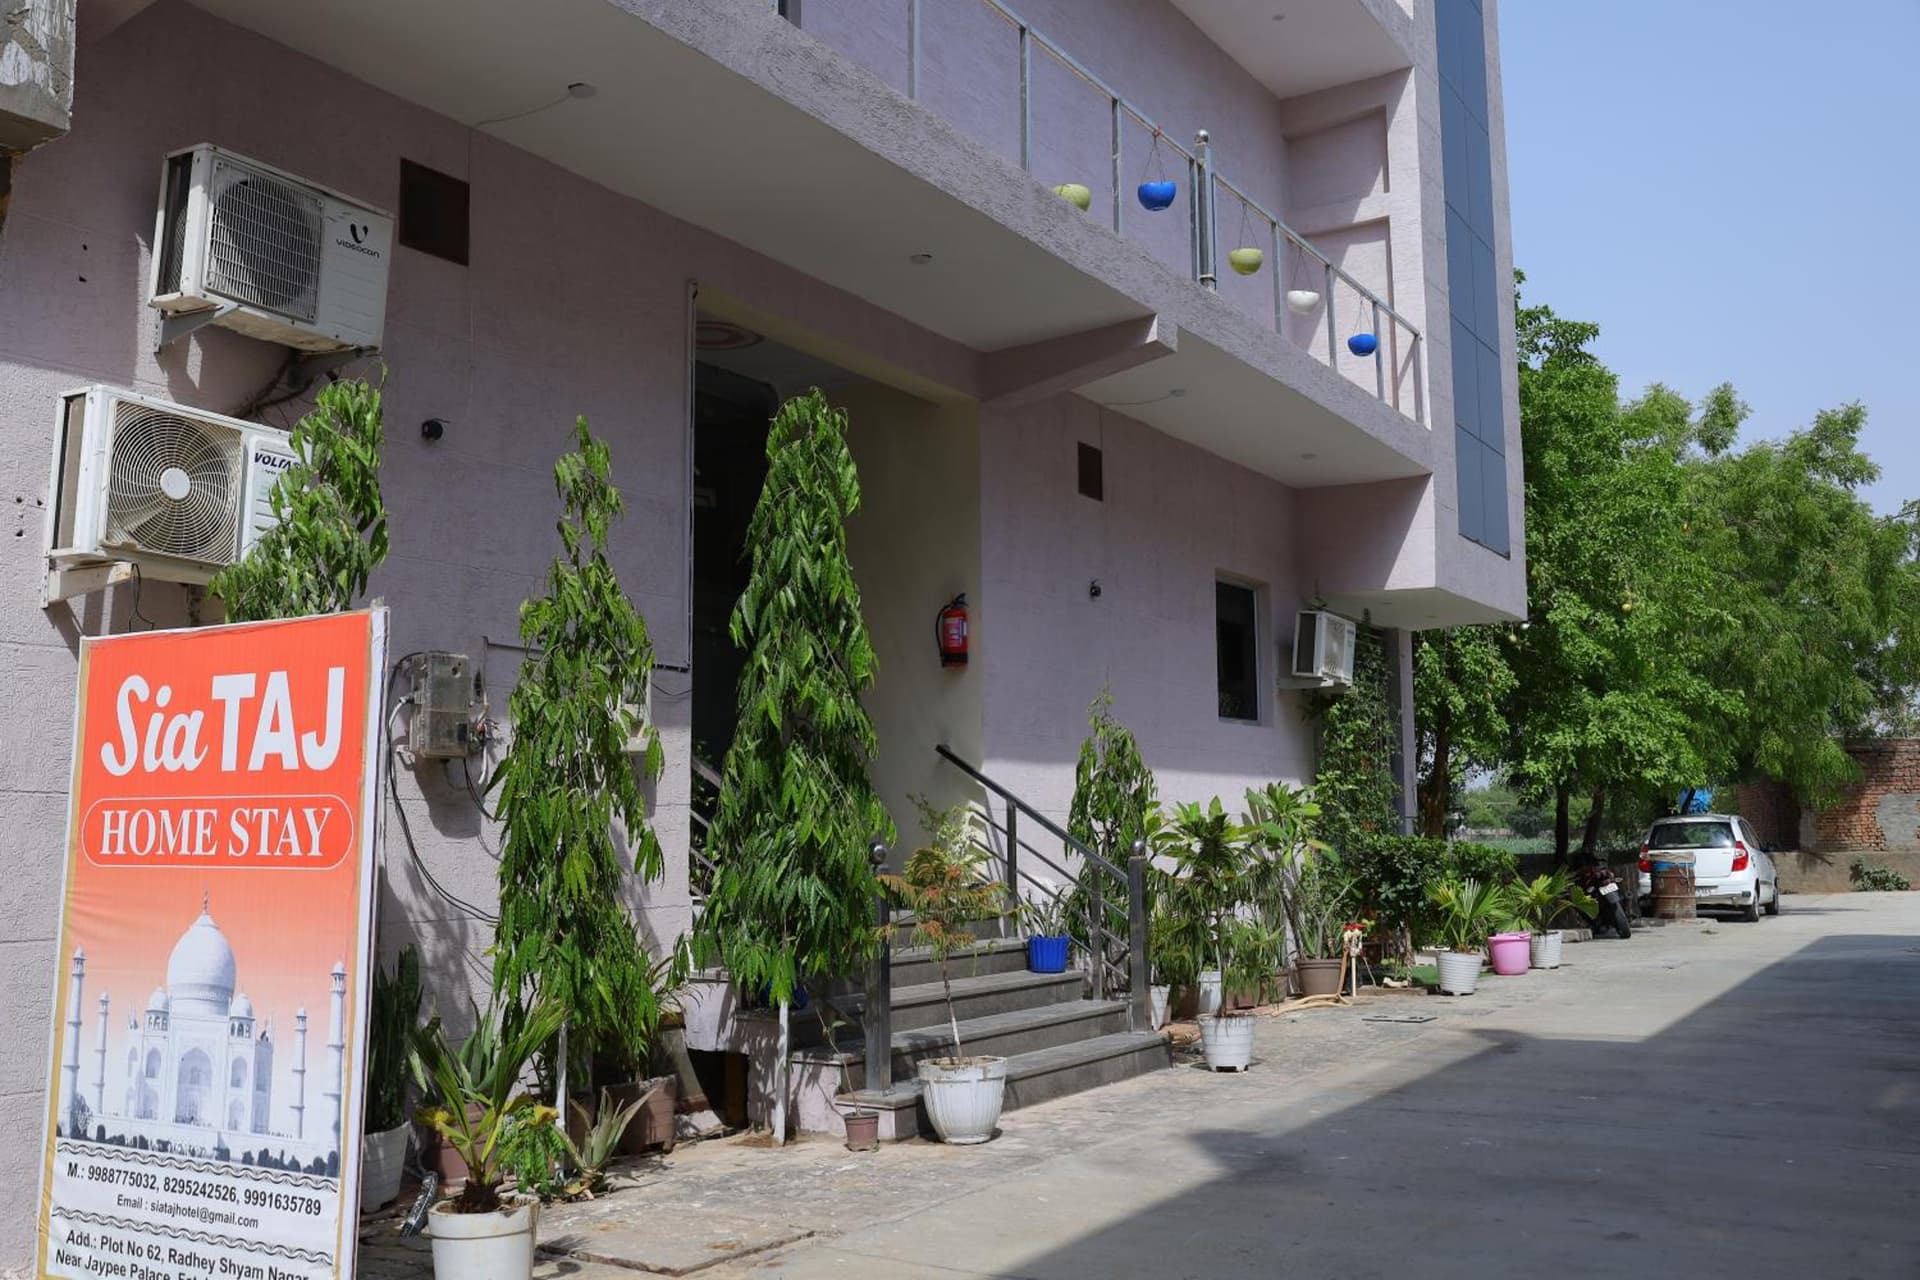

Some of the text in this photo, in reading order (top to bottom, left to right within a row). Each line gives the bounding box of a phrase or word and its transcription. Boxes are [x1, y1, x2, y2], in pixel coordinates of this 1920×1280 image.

[101, 667, 345, 776] Sia TAJ
[100, 807, 332, 857] HOME STAY
[88, 1165, 160, 1192] 9988775032,
[163, 1177, 239, 1204] 8295242526,
[244, 1188, 321, 1216] 9991635789
[117, 1194, 143, 1209] Email
[151, 1200, 258, 1229] siatajhotel@gmail.com
[56, 1249, 81, 1267] Near
[84, 1255, 126, 1277] Jaypee
[100, 1235, 123, 1254] Plot
[127, 1241, 144, 1258] No
[147, 1244, 164, 1264] 62,
[168, 1248, 215, 1274] Radhey
[220, 1257, 264, 1280] Shyam
